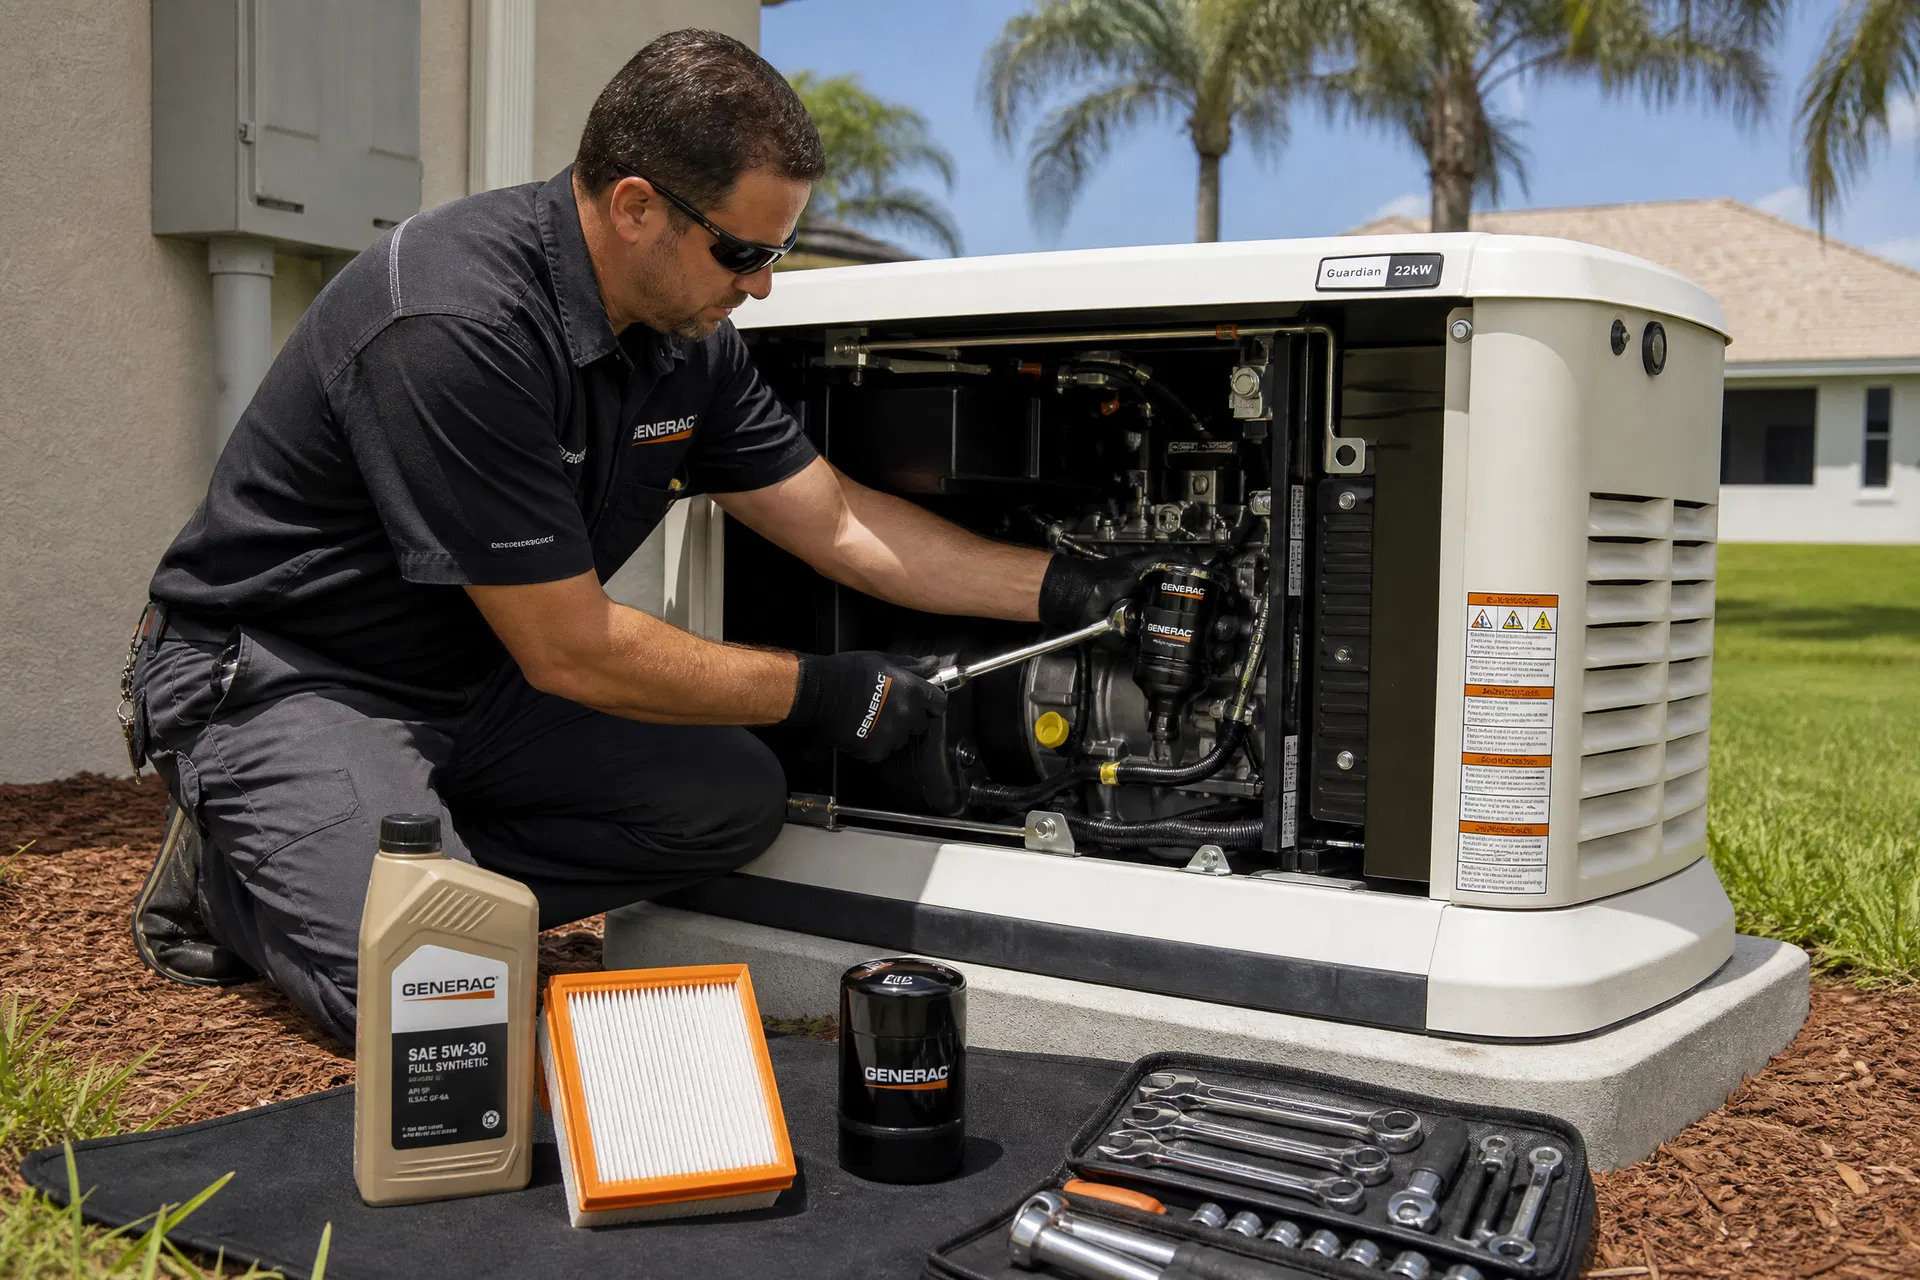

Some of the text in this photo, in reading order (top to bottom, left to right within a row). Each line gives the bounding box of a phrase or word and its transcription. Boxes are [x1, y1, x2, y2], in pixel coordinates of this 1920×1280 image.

[1327, 264, 1433, 278] Guardian 22kW
[1161, 582, 1205, 595] GENERAC
[1147, 623, 1192, 637] GENERAC
[856, 674, 886, 738] GENERAC
[402, 976, 496, 997] GENERAC
[408, 1041, 486, 1062] SAE 5W-30
[408, 1057, 489, 1074] FULL SYNTHETIC
[865, 1065, 948, 1083] GENERAC
[408, 1095, 428, 1103] ILSAC
